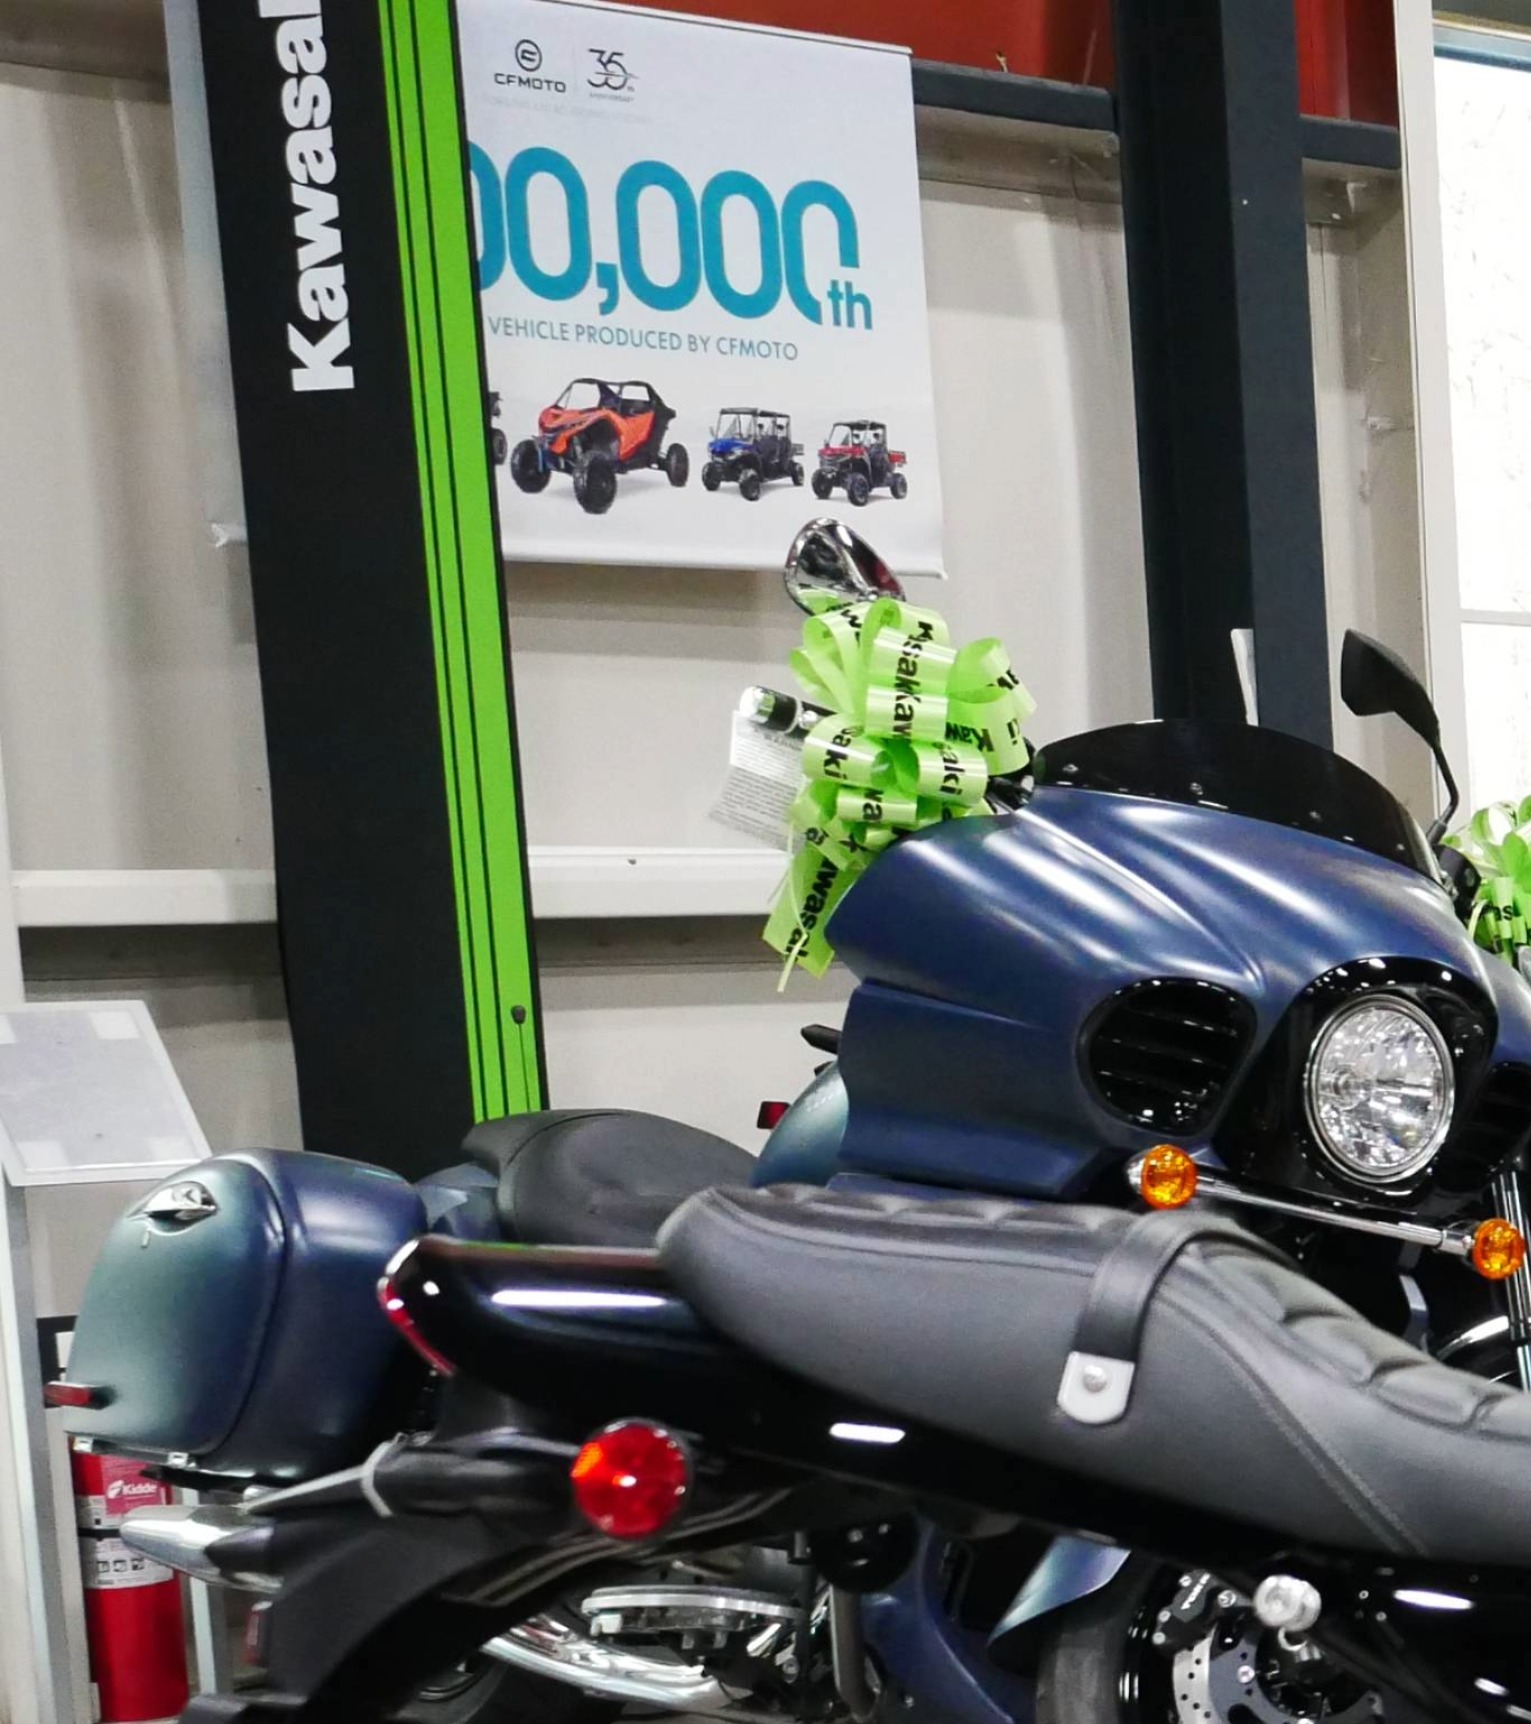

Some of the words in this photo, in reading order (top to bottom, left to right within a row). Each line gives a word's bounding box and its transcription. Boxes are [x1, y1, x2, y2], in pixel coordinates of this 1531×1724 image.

[494, 72, 567, 94] CFMOTO
[488, 315, 570, 342] VEHICLE
[575, 325, 682, 352] PRODUCED
[687, 335, 711, 354] BY
[716, 337, 799, 361] CFMOTO
